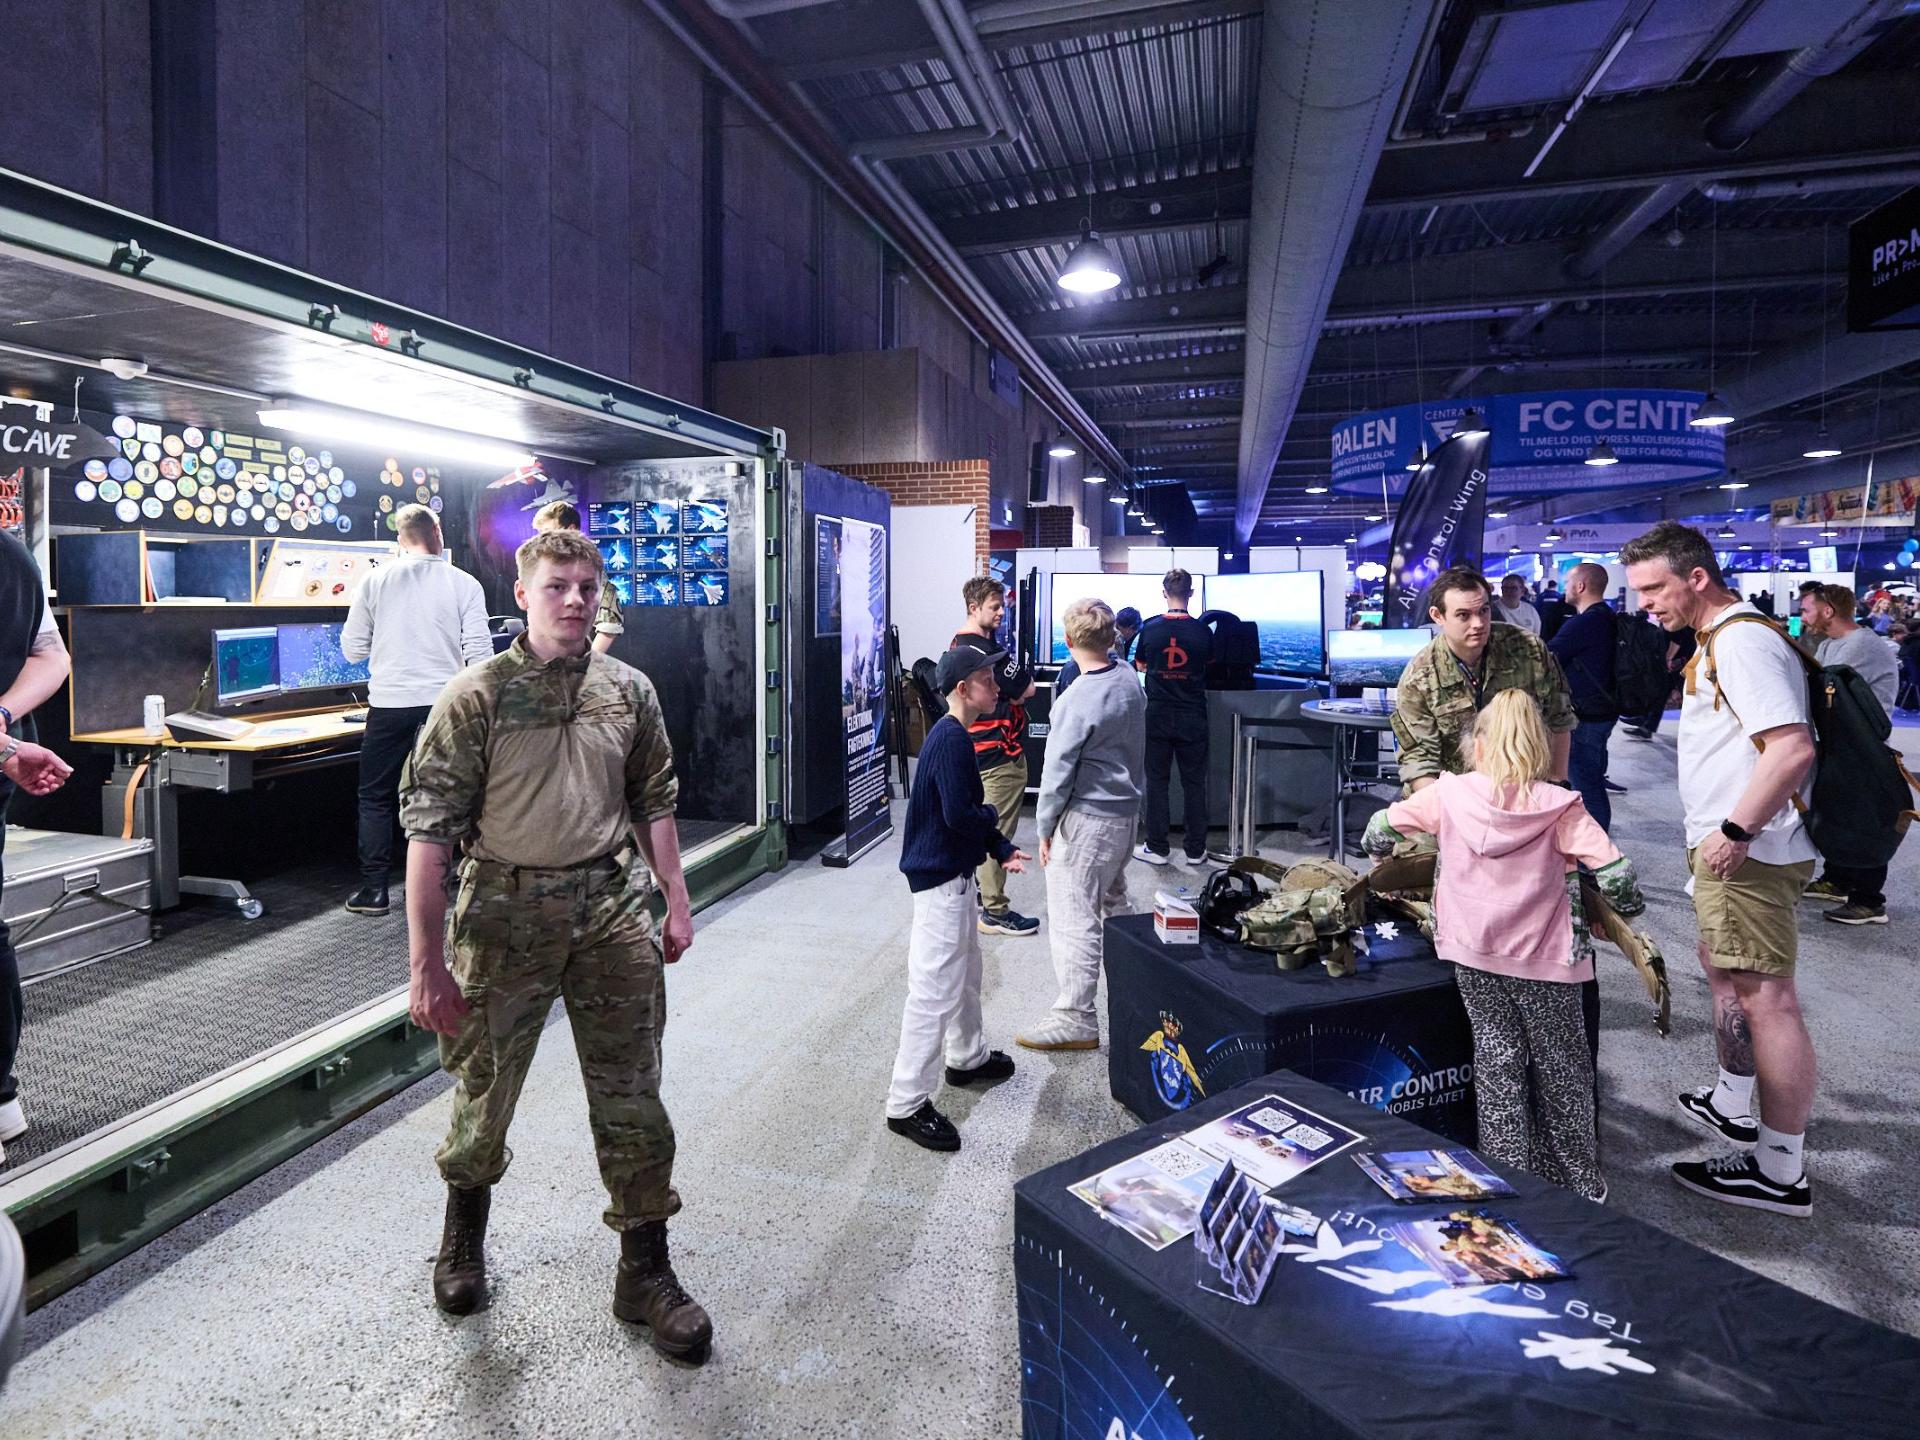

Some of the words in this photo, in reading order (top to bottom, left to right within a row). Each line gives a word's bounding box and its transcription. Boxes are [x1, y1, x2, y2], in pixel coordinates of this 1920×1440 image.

[1424, 406, 1486, 421] CENTRAN
[1519, 400, 1575, 433] FC
[1584, 399, 1724, 436] CENTR
[0, 424, 77, 459] CAVE
[1519, 435, 1569, 447] TILMELD
[1571, 435, 1592, 445] DIG
[1594, 434, 1630, 444] VORES
[1533, 448, 1553, 458] OG
[1555, 447, 1585, 457] VIND
[1398, 583, 1420, 610] Air
[1450, 468, 1487, 513] Wing
[1390, 1064, 1473, 1100] CONTRO
[1384, 1098, 1425, 1115] NOBIS
[1429, 1088, 1466, 1107] LATET
[1565, 1300, 1642, 1343] Tag
